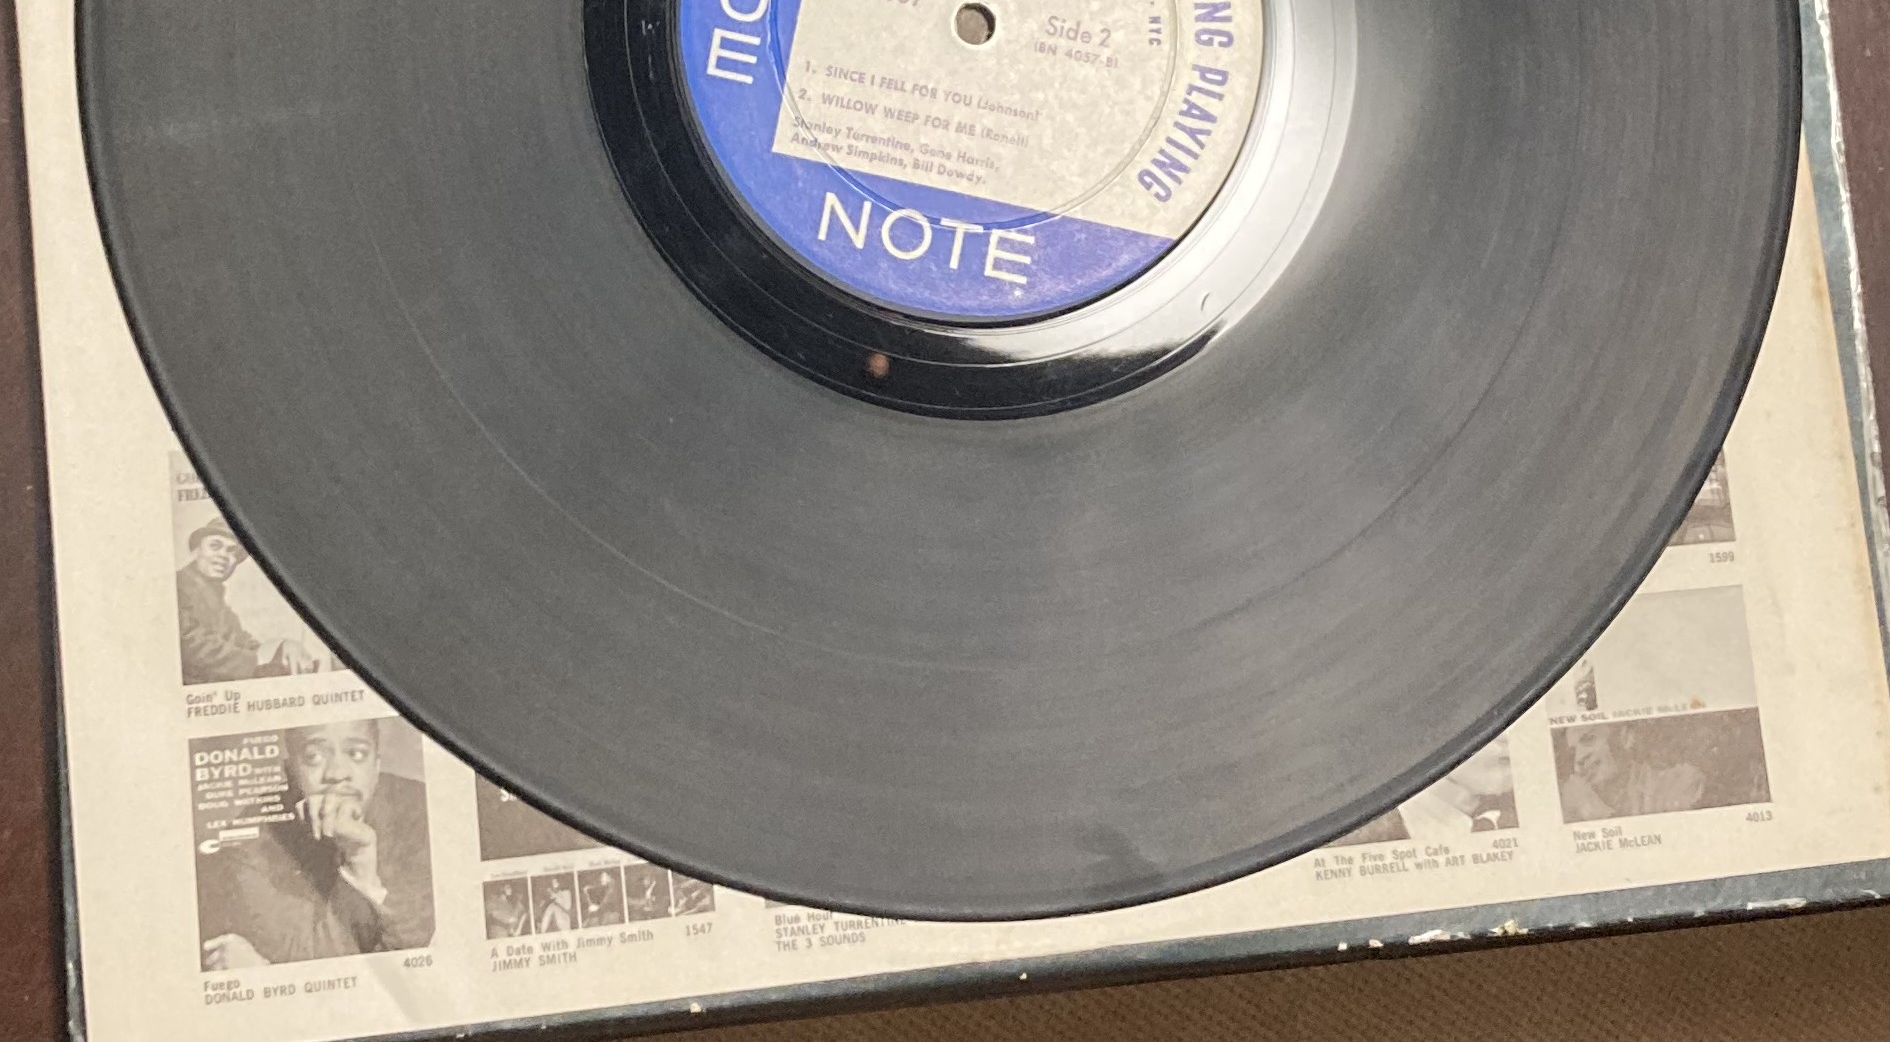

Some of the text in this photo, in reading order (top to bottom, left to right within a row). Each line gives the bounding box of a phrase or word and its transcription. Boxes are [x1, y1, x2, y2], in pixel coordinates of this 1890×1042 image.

[1045, 15, 1112, 48] Side 2
[1148, 15, 1162, 47] NYC
[804, 60, 816, 74] 1.
[825, 65, 866, 85] SINCE
[870, 74, 875, 86] I
[879, 77, 907, 93] FELL
[911, 83, 938, 99] FOR
[943, 90, 973, 107] YOU
[798, 88, 811, 102] 2.
[821, 92, 878, 115] WILLOW
[884, 106, 920, 123] WEEP
[924, 115, 950, 130] FOR
[954, 121, 976, 136] ME
[793, 115, 841, 138] Stanley
[846, 126, 914, 153] Turrentine,
[919, 143, 952, 161] Gene
[1137, 64, 1230, 203] PLAYING
[791, 131, 843, 153] Andrew
[845, 144, 908, 169] Simpkins,
[912, 157, 933, 174] Bill
[816, 191, 1037, 284] NOTE
[1708, 551, 1735, 564] 1599
[187, 689, 365, 718] FREDDIE HUBBARD QUINTET
[225, 690, 241, 702] Up
[1550, 717, 1577, 725] NEW
[1581, 712, 1607, 722] SOIL
[194, 745, 280, 766] DONALD
[195, 763, 252, 781] BYRD
[1746, 810, 1773, 822] 4013
[1492, 837, 1519, 849] 4021
[1573, 826, 1623, 841] New Soil
[1576, 834, 1662, 853] JACKIE McLEAN
[1314, 844, 1450, 869] At The Five Spot Cafe
[1315, 850, 1514, 881] KENNY BURRELL with ART BLAKEY
[685, 923, 713, 937] 1547
[775, 914, 801, 926] Blue
[776, 924, 825, 938] STANLEY
[776, 932, 866, 951] THE 3 SOUNDS
[491, 930, 654, 958] A Date With Jimmy Smith
[403, 955, 433, 968] 4026
[492, 951, 577, 972] JIMMY SMITH
[204, 980, 240, 993] Fuego
[205, 976, 358, 1006] DONALD BYRD QUINTET
